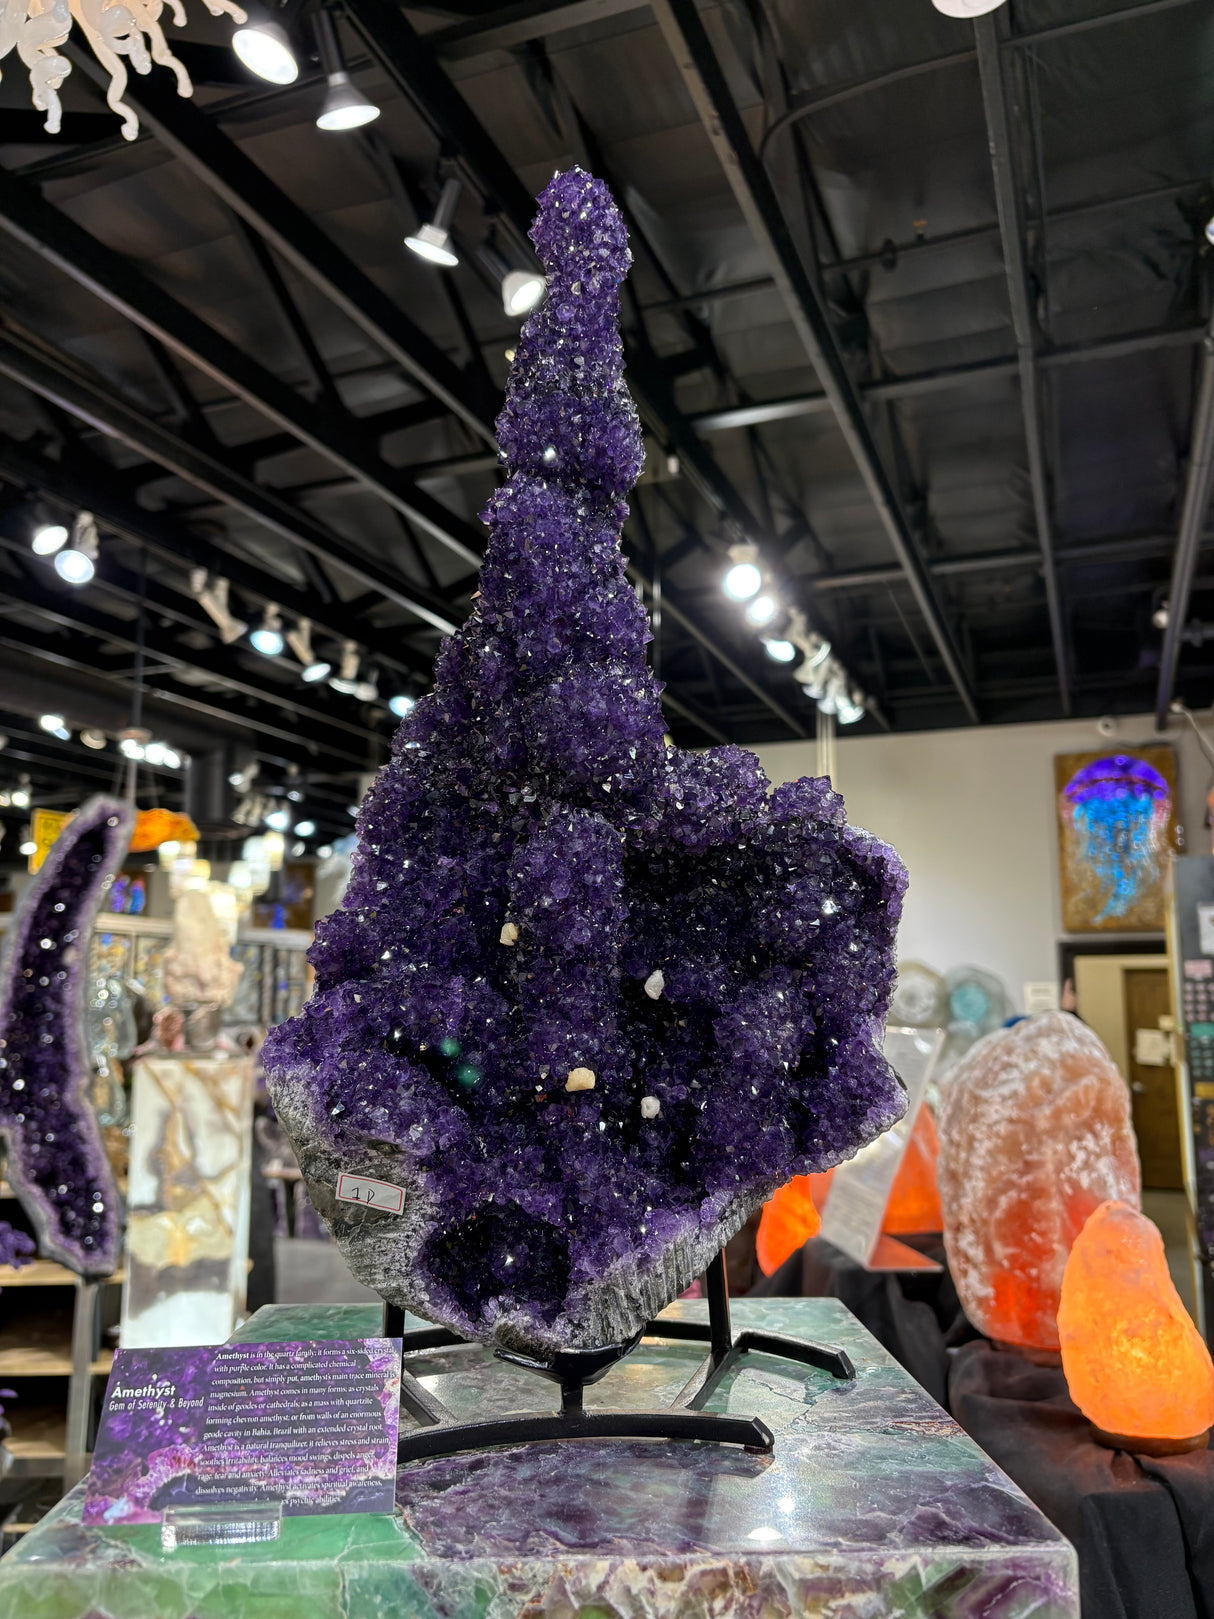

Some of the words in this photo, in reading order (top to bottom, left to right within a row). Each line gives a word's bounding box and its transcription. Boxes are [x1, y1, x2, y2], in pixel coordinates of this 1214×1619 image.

[216, 1352, 249, 1360] Amethyst
[275, 1351, 294, 1359] quartz
[323, 1348, 340, 1356] forms
[229, 1364, 249, 1373] purple
[291, 1361, 328, 1370] complicated
[329, 1360, 356, 1368] chemical
[212, 1377, 252, 1386] composition,
[265, 1374, 286, 1384] simply
[287, 1376, 299, 1384] put,
[300, 1373, 331, 1382] amethyst's
[111, 1385, 176, 1399] Amethyst
[249, 1388, 279, 1397] Amethyst
[355, 1384, 379, 1393] crystals
[109, 1401, 125, 1410] Gem
[128, 1399, 136, 1410] of
[138, 1400, 167, 1410] Serenity
[170, 1398, 175, 1408] &
[178, 1396, 204, 1409] Beyond
[228, 1402, 235, 1410] of
[235, 1402, 257, 1412] geodes
[330, 1398, 344, 1406] with
[345, 1398, 373, 1407] quartzite
[206, 1417, 232, 1426] forming
[233, 1415, 258, 1423] chevron
[300, 1412, 315, 1420] from
[203, 1430, 222, 1440] geode
[224, 1430, 242, 1438] cavity
[273, 1426, 292, 1434] Brazil
[293, 1426, 306, 1434] with
[317, 1424, 345, 1432] extended
[347, 1423, 368, 1433] crystal
[203, 1444, 233, 1452] Amethyst
[246, 1441, 269, 1449] natural
[315, 1438, 338, 1446] relieves
[260, 1454, 287, 1463] balances
[333, 1452, 354, 1460] dispels
[228, 1471, 240, 1479] and
[269, 1468, 298, 1476] Alleviates
[300, 1467, 324, 1475] sadness
[326, 1466, 338, 1474] and
[196, 1486, 224, 1495] dissolves
[261, 1484, 291, 1492] Amethyst
[321, 1480, 347, 1490] spiritual
